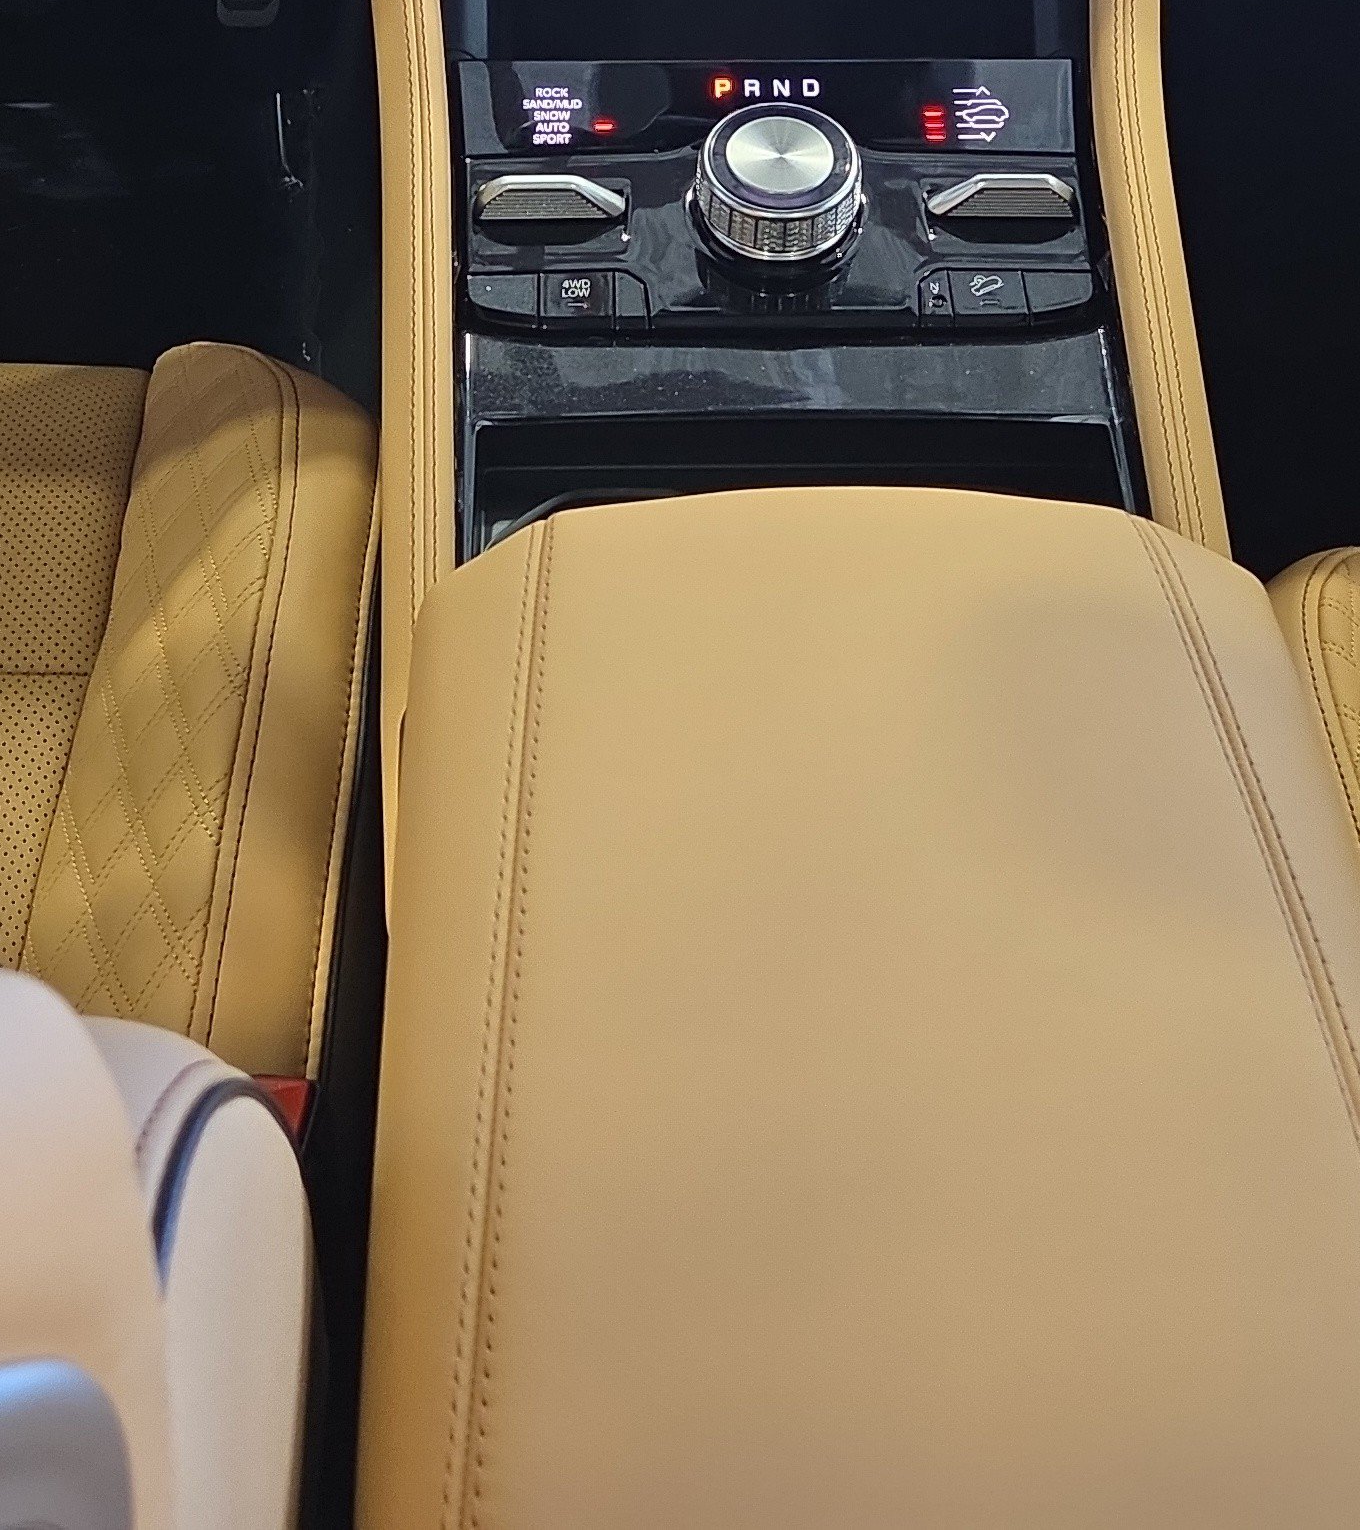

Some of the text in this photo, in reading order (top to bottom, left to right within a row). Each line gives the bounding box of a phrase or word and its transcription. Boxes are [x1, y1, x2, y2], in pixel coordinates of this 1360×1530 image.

[535, 87, 569, 98] ROCK
[714, 78, 820, 98] P R N D
[522, 99, 583, 109] SAND/MUD
[533, 110, 571, 121] SNOW
[535, 122, 570, 132] AUTO
[532, 133, 572, 145] SPORT
[562, 278, 591, 288] 4WD
[561, 288, 591, 298] LOW
